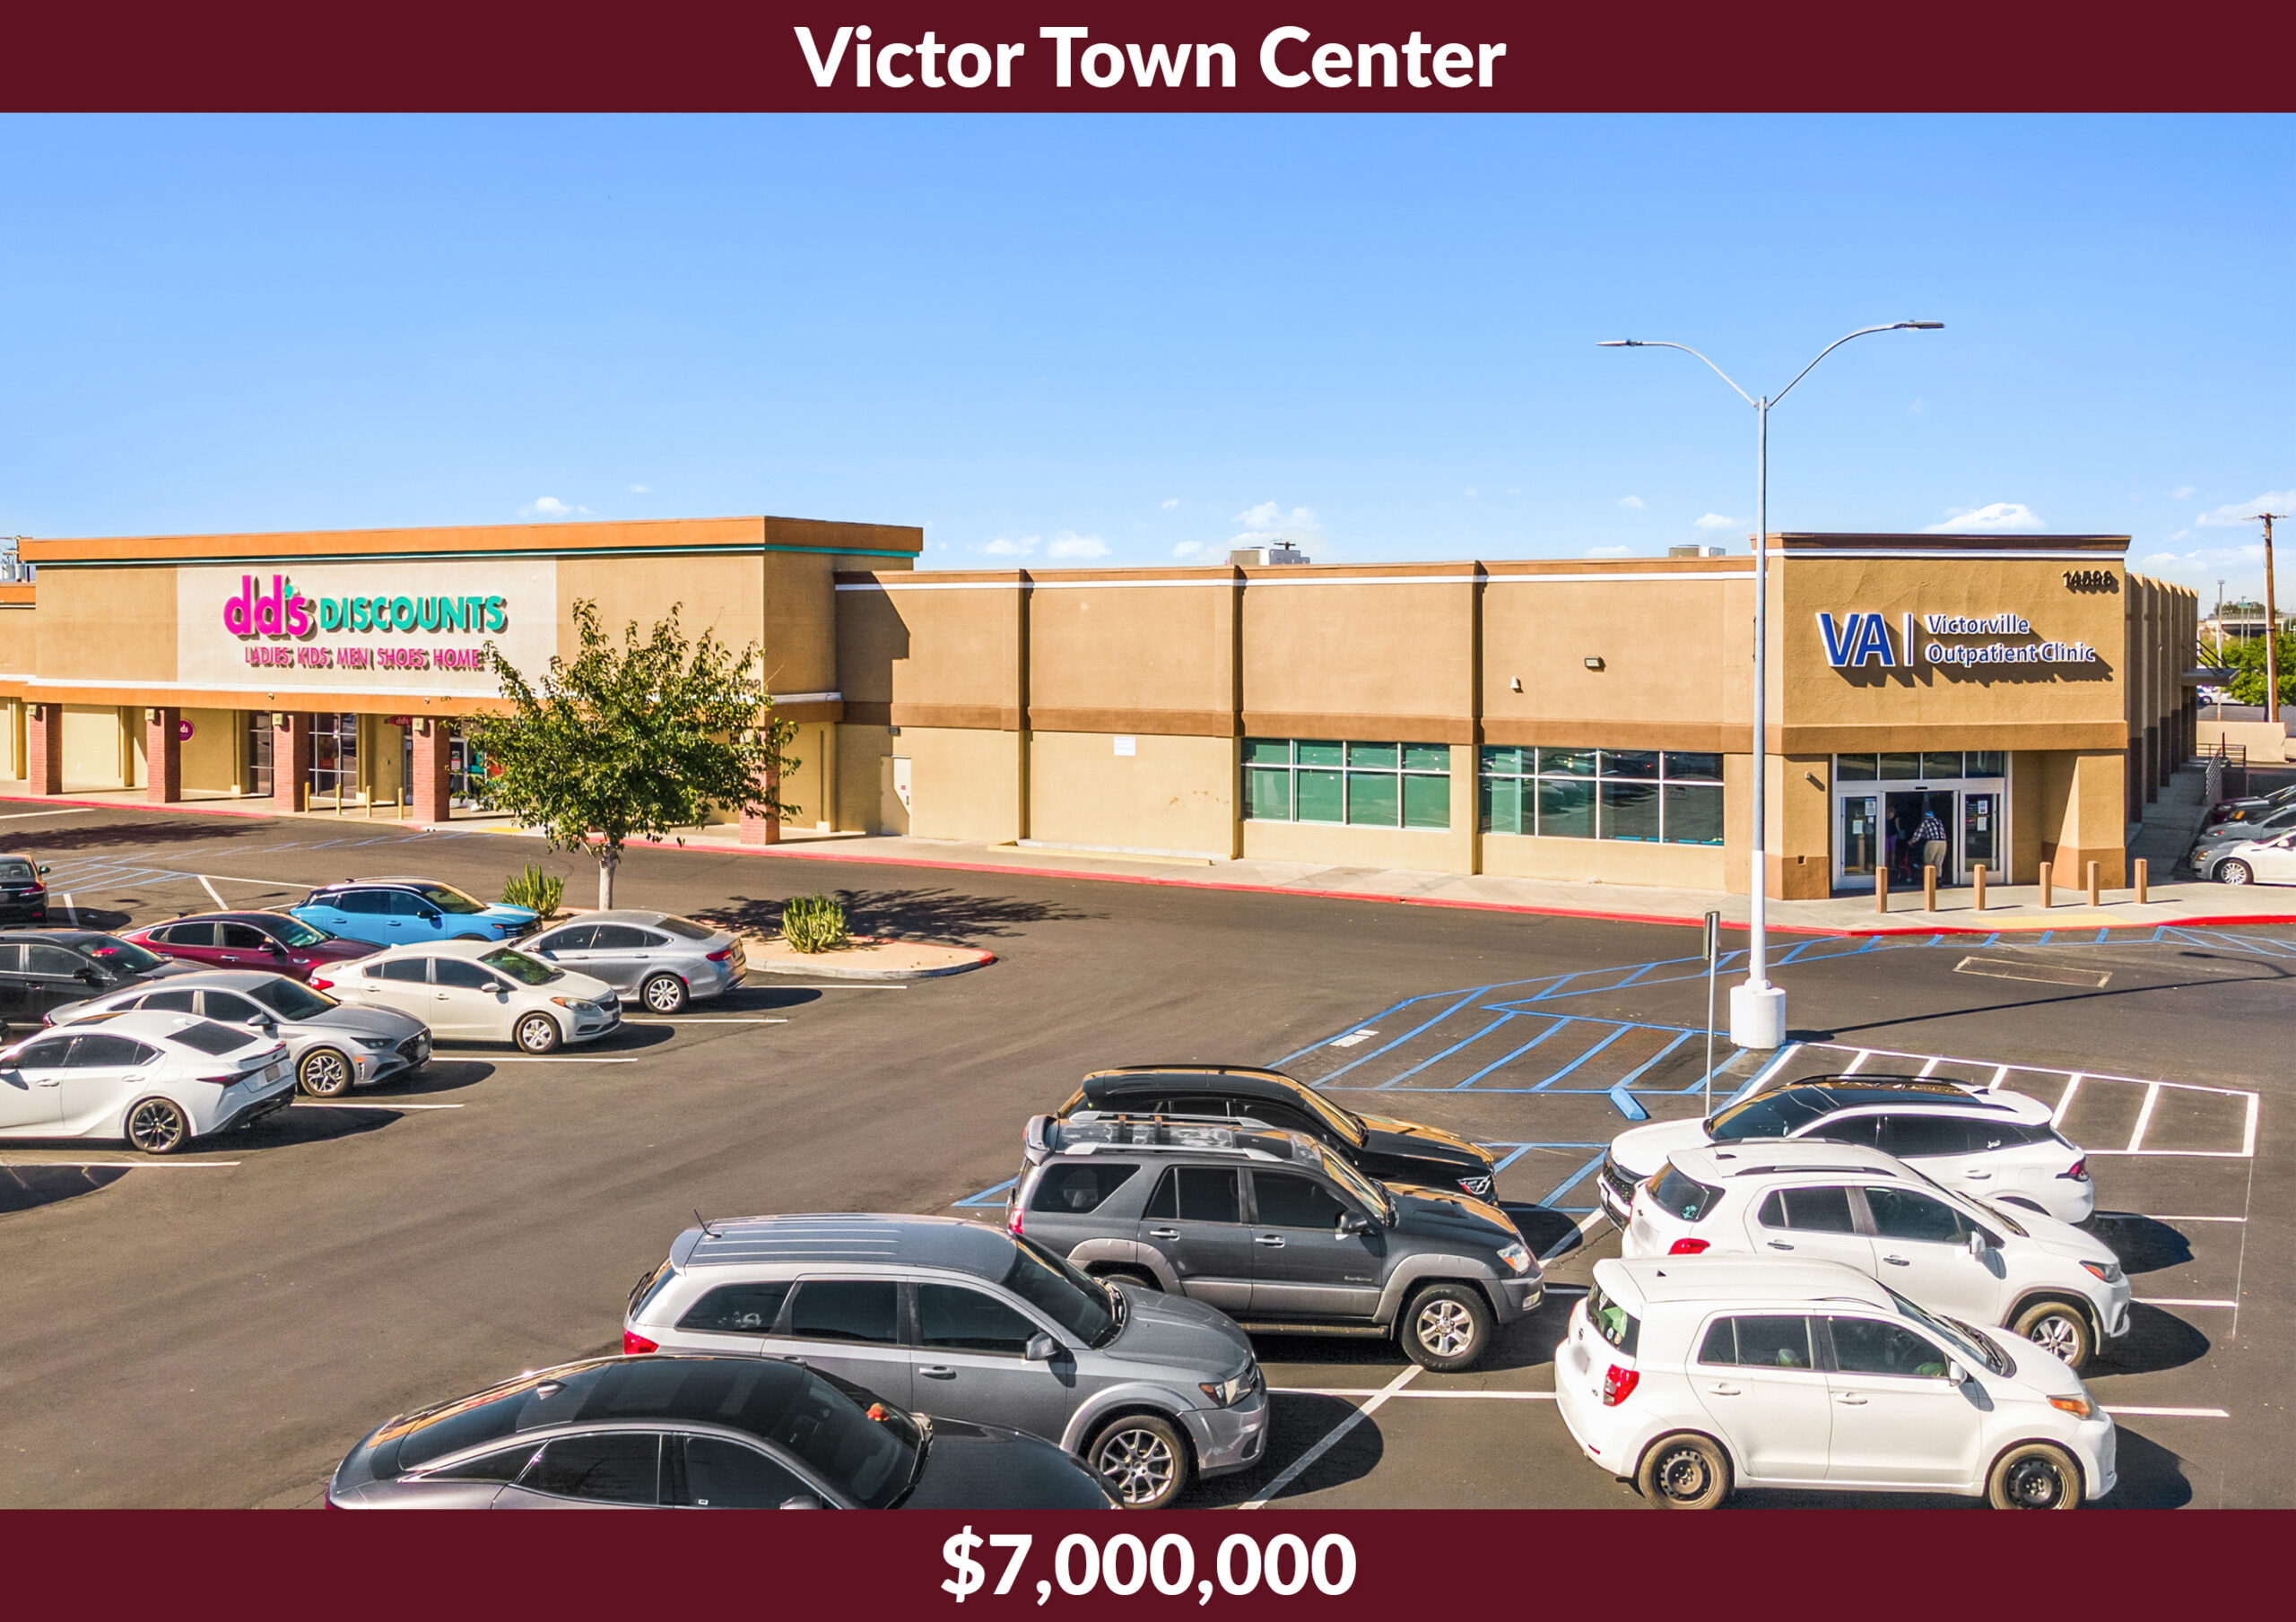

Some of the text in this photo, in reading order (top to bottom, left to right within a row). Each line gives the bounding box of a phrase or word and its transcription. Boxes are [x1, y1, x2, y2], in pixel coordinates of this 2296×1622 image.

[223, 574, 504, 636] dd's DISCOUNTS
[1924, 614, 2031, 635] Victorville
[1815, 612, 1896, 667] VA
[245, 646, 480, 668] LADIES KIDS MEN SHOES HOME
[1925, 641, 2096, 667] Outpatient Clinic
